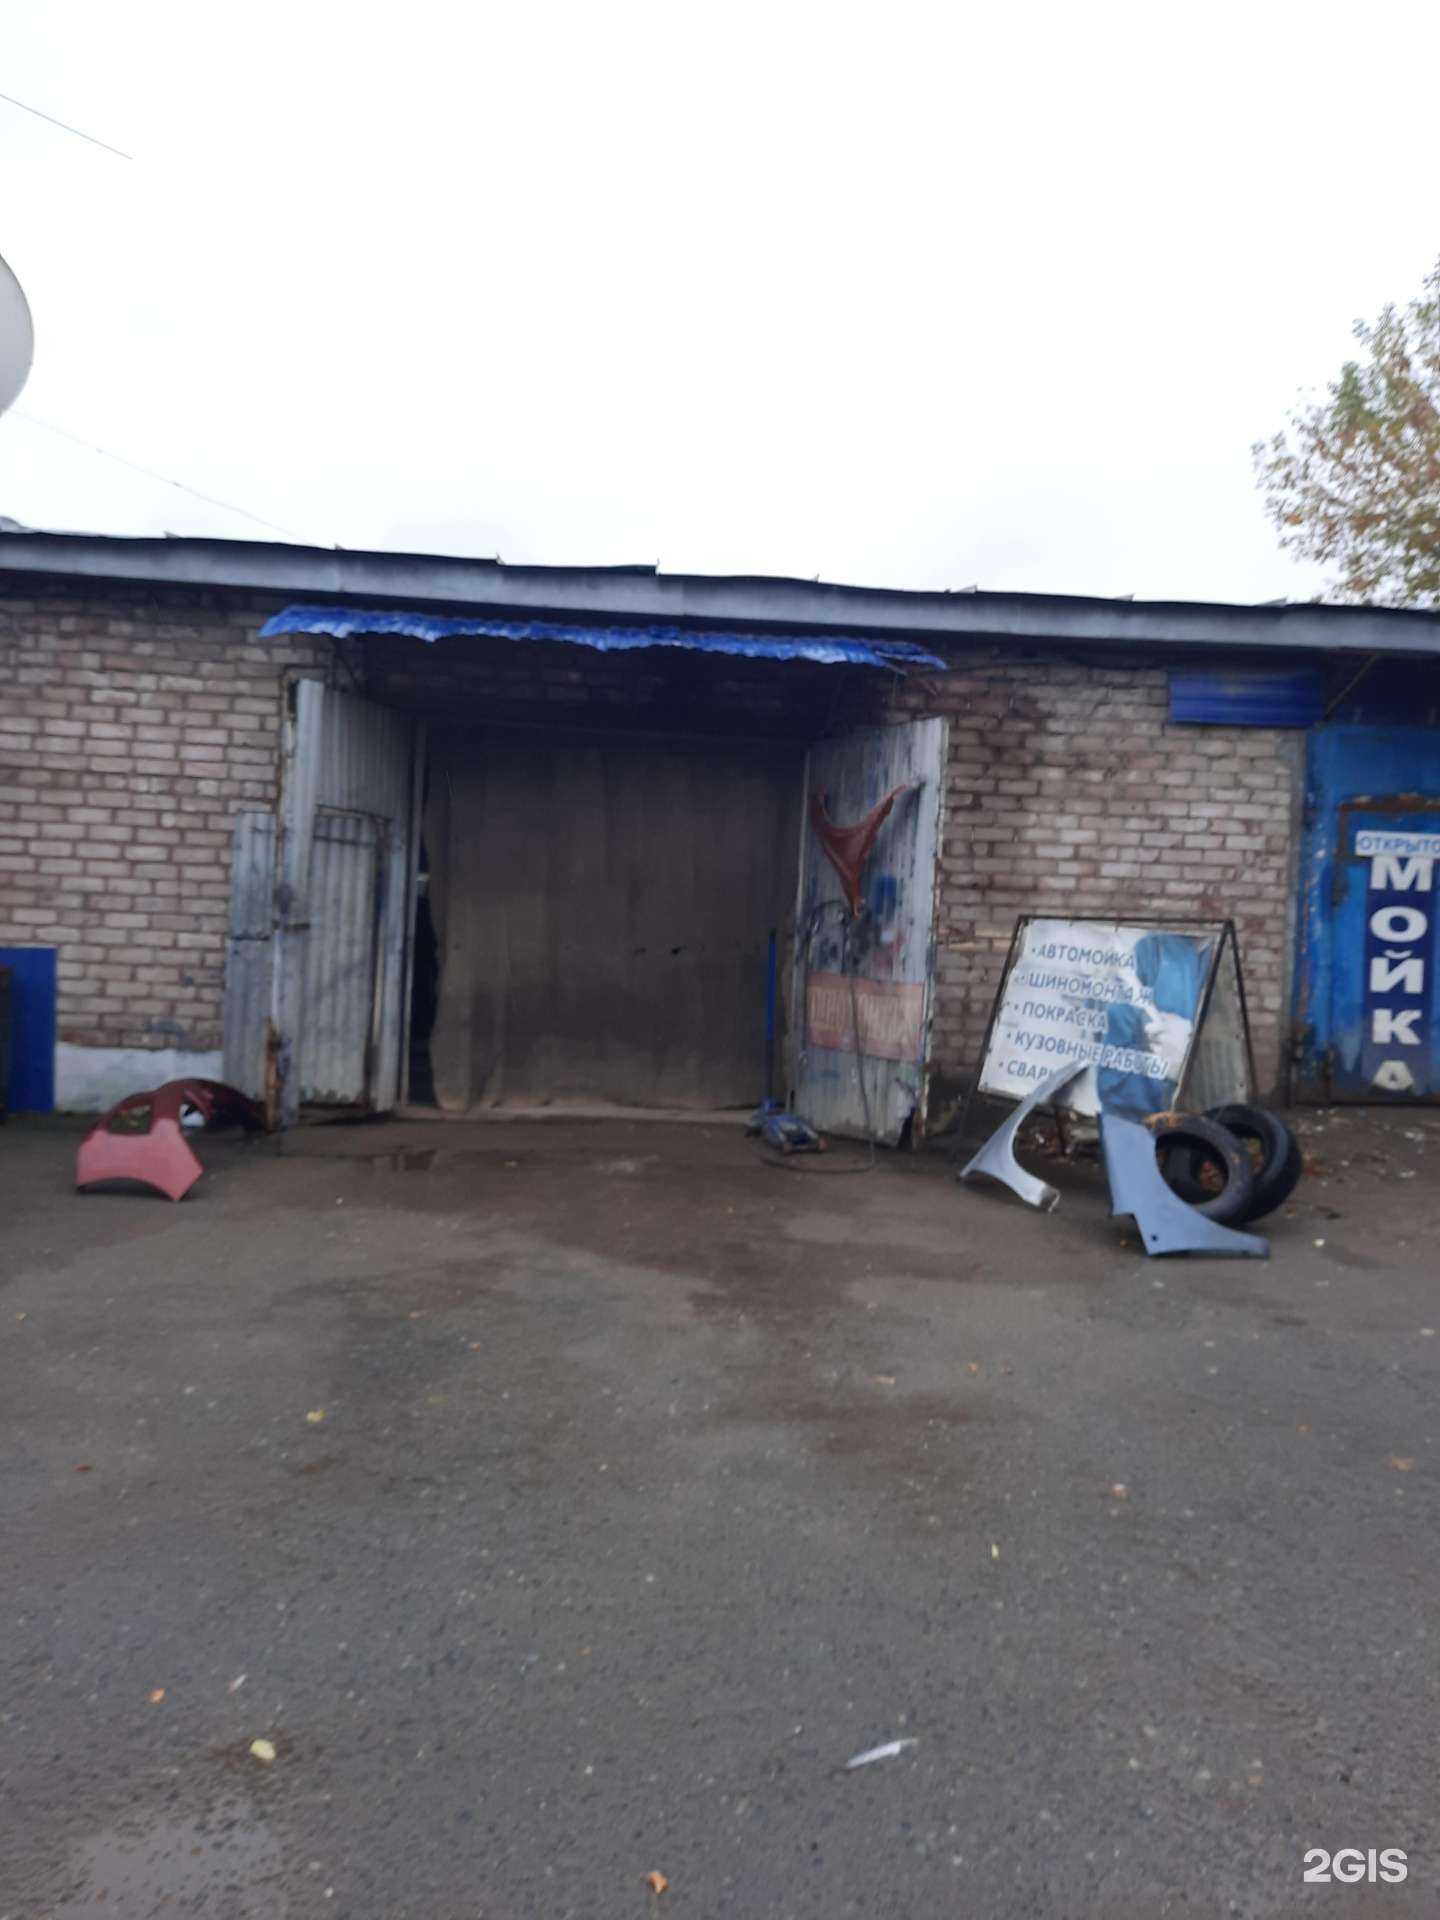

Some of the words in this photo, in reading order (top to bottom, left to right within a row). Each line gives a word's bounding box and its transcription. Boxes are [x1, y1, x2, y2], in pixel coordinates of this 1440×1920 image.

[1038, 943, 1135, 969] АВТОМОЙКА
[1369, 855, 1434, 1091] МОЙКА
[1028, 972, 1153, 1005] ШИНОМОНТАЖ
[1021, 1001, 1108, 1029] ПОКРАСКА
[1014, 1031, 1099, 1063] КУЗОВНЫЕ
[1102, 1046, 1168, 1076] РАБОТЫ
[1007, 1060, 1054, 1081] СВАР
